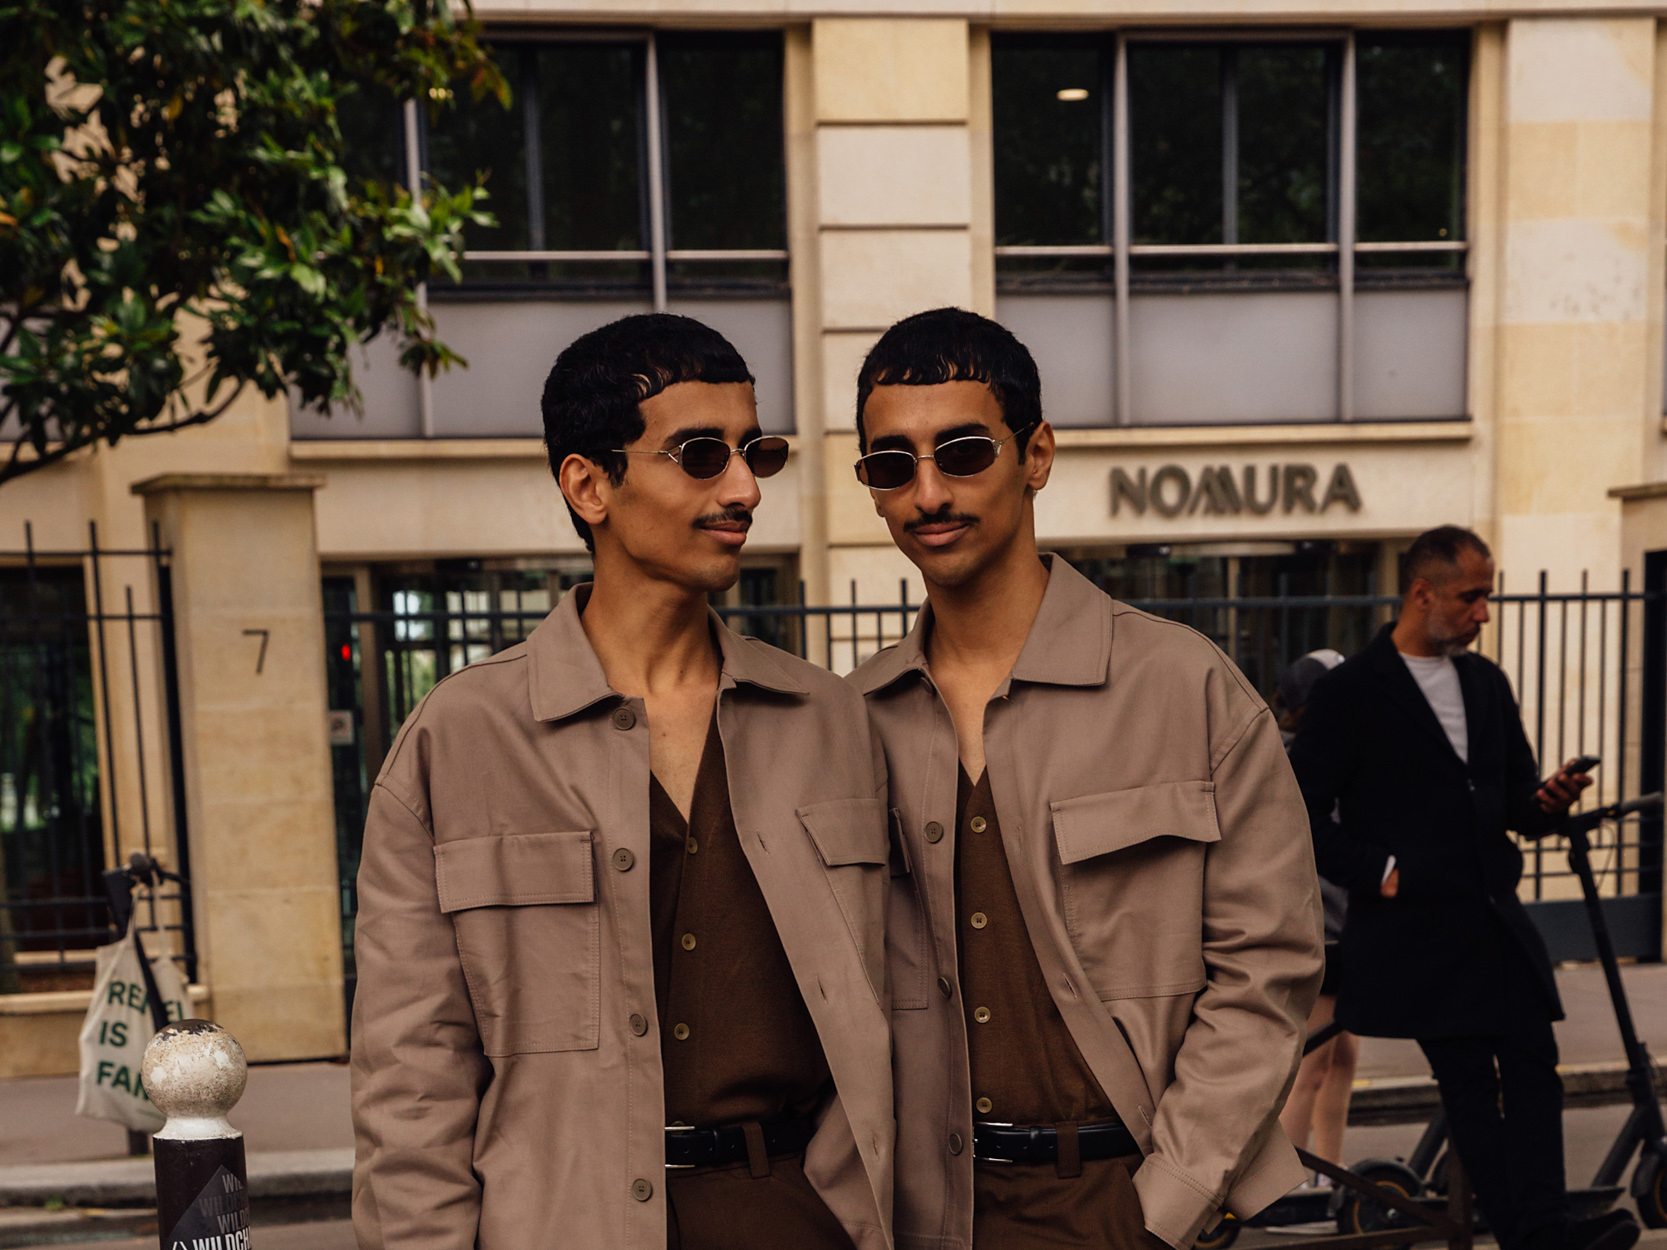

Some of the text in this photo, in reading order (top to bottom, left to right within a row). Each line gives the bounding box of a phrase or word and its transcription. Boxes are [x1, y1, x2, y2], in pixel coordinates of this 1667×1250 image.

[1107, 463, 1363, 517] NOMURA
[241, 629, 270, 675] 7
[100, 1021, 128, 1047] IS
